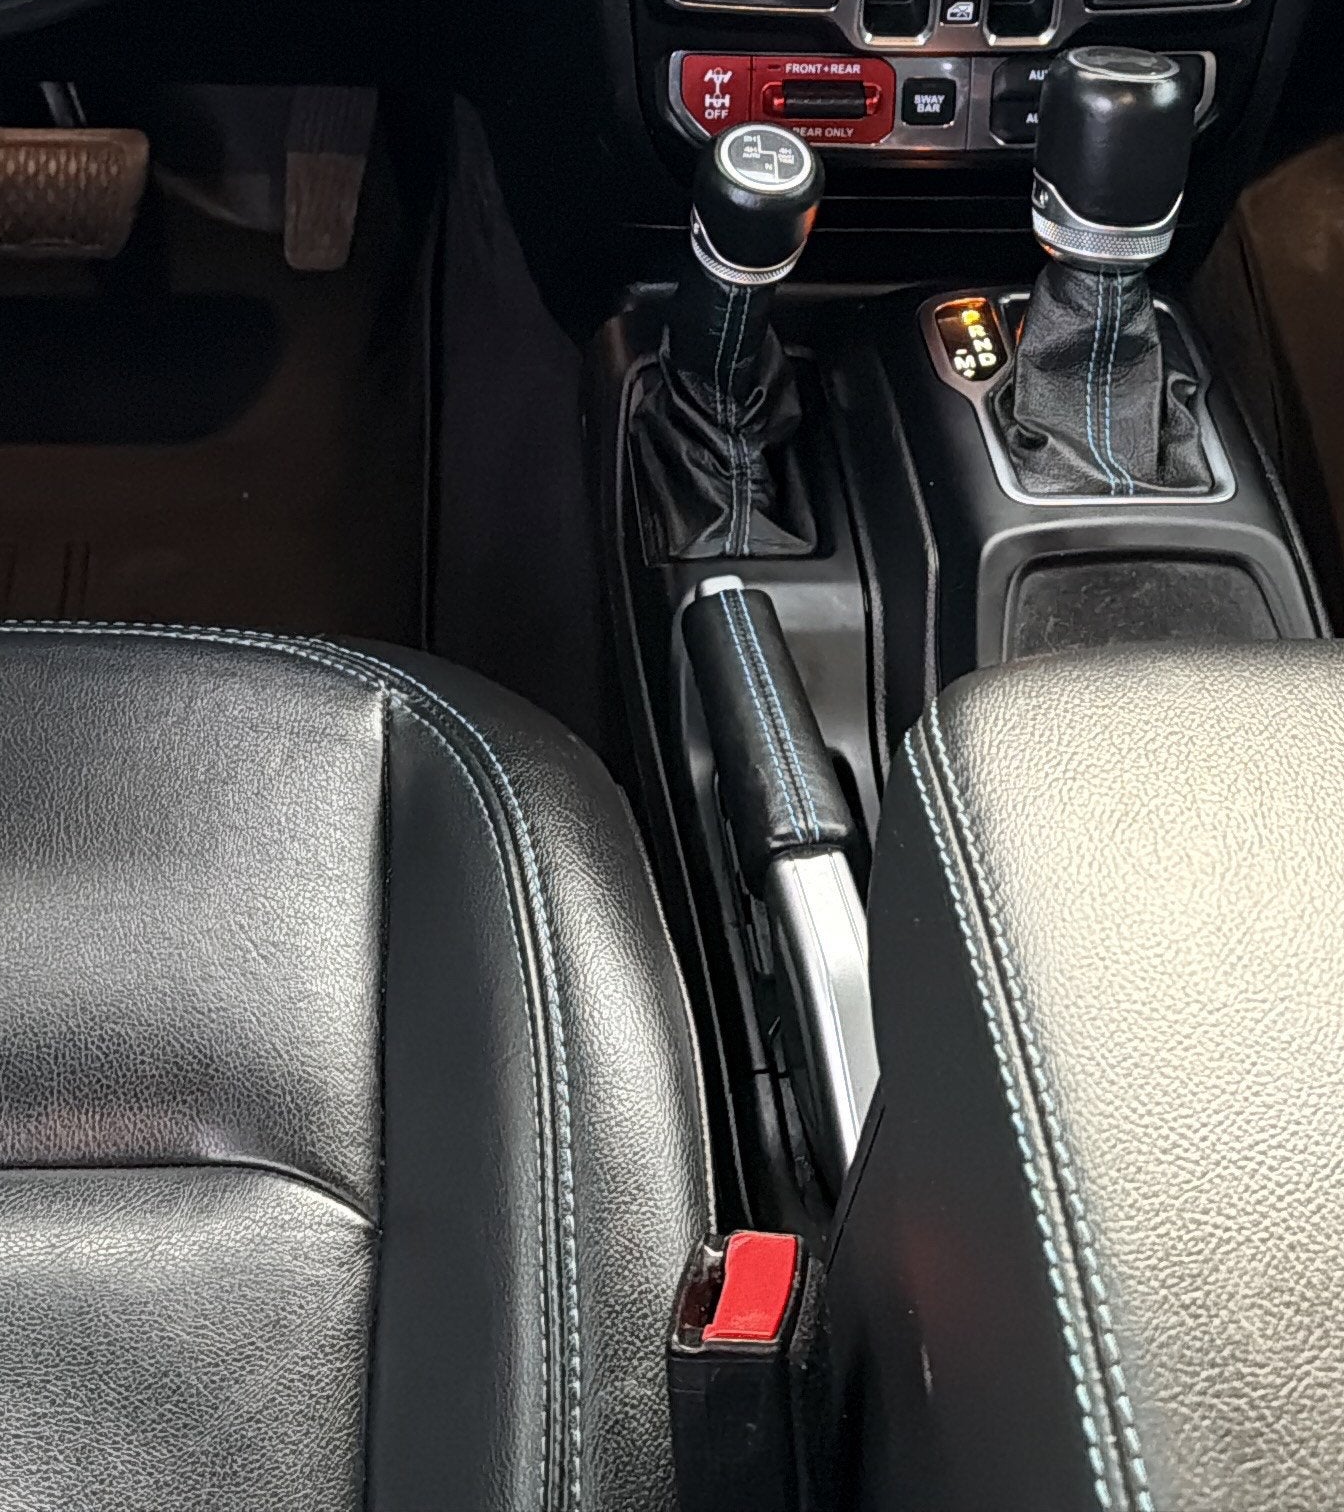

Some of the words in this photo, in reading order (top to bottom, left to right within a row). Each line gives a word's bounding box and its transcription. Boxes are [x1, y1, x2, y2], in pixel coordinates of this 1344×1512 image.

[784, 63, 863, 76] FRONT+REAR
[912, 94, 946, 107] SWAY
[705, 107, 730, 120] OFF
[916, 104, 942, 115] BAR
[826, 128, 856, 139] ONLY
[968, 324, 987, 338] R
[973, 337, 993, 353] N
[953, 354, 977, 371] M
[978, 352, 997, 367] D
